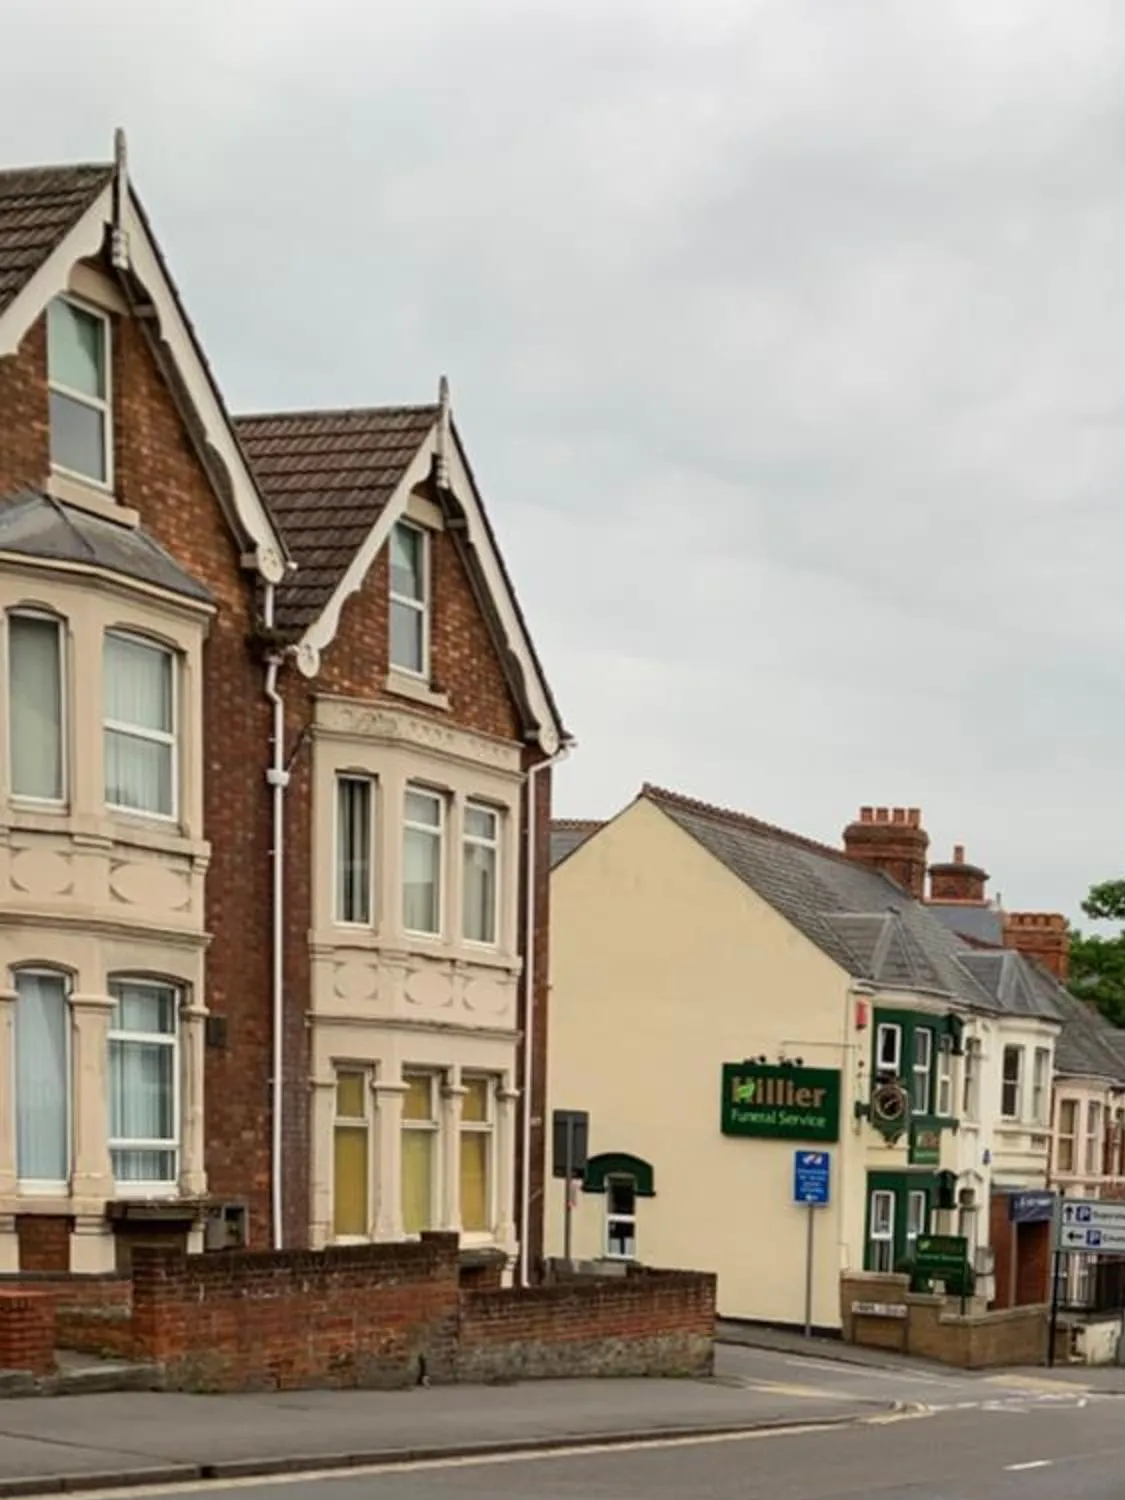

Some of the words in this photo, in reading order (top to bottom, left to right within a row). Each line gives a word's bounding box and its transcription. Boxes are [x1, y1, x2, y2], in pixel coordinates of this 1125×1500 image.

[731, 1075, 827, 1109] Hillier
[731, 1108, 777, 1124] Funeral
[778, 1109, 827, 1128] Service
